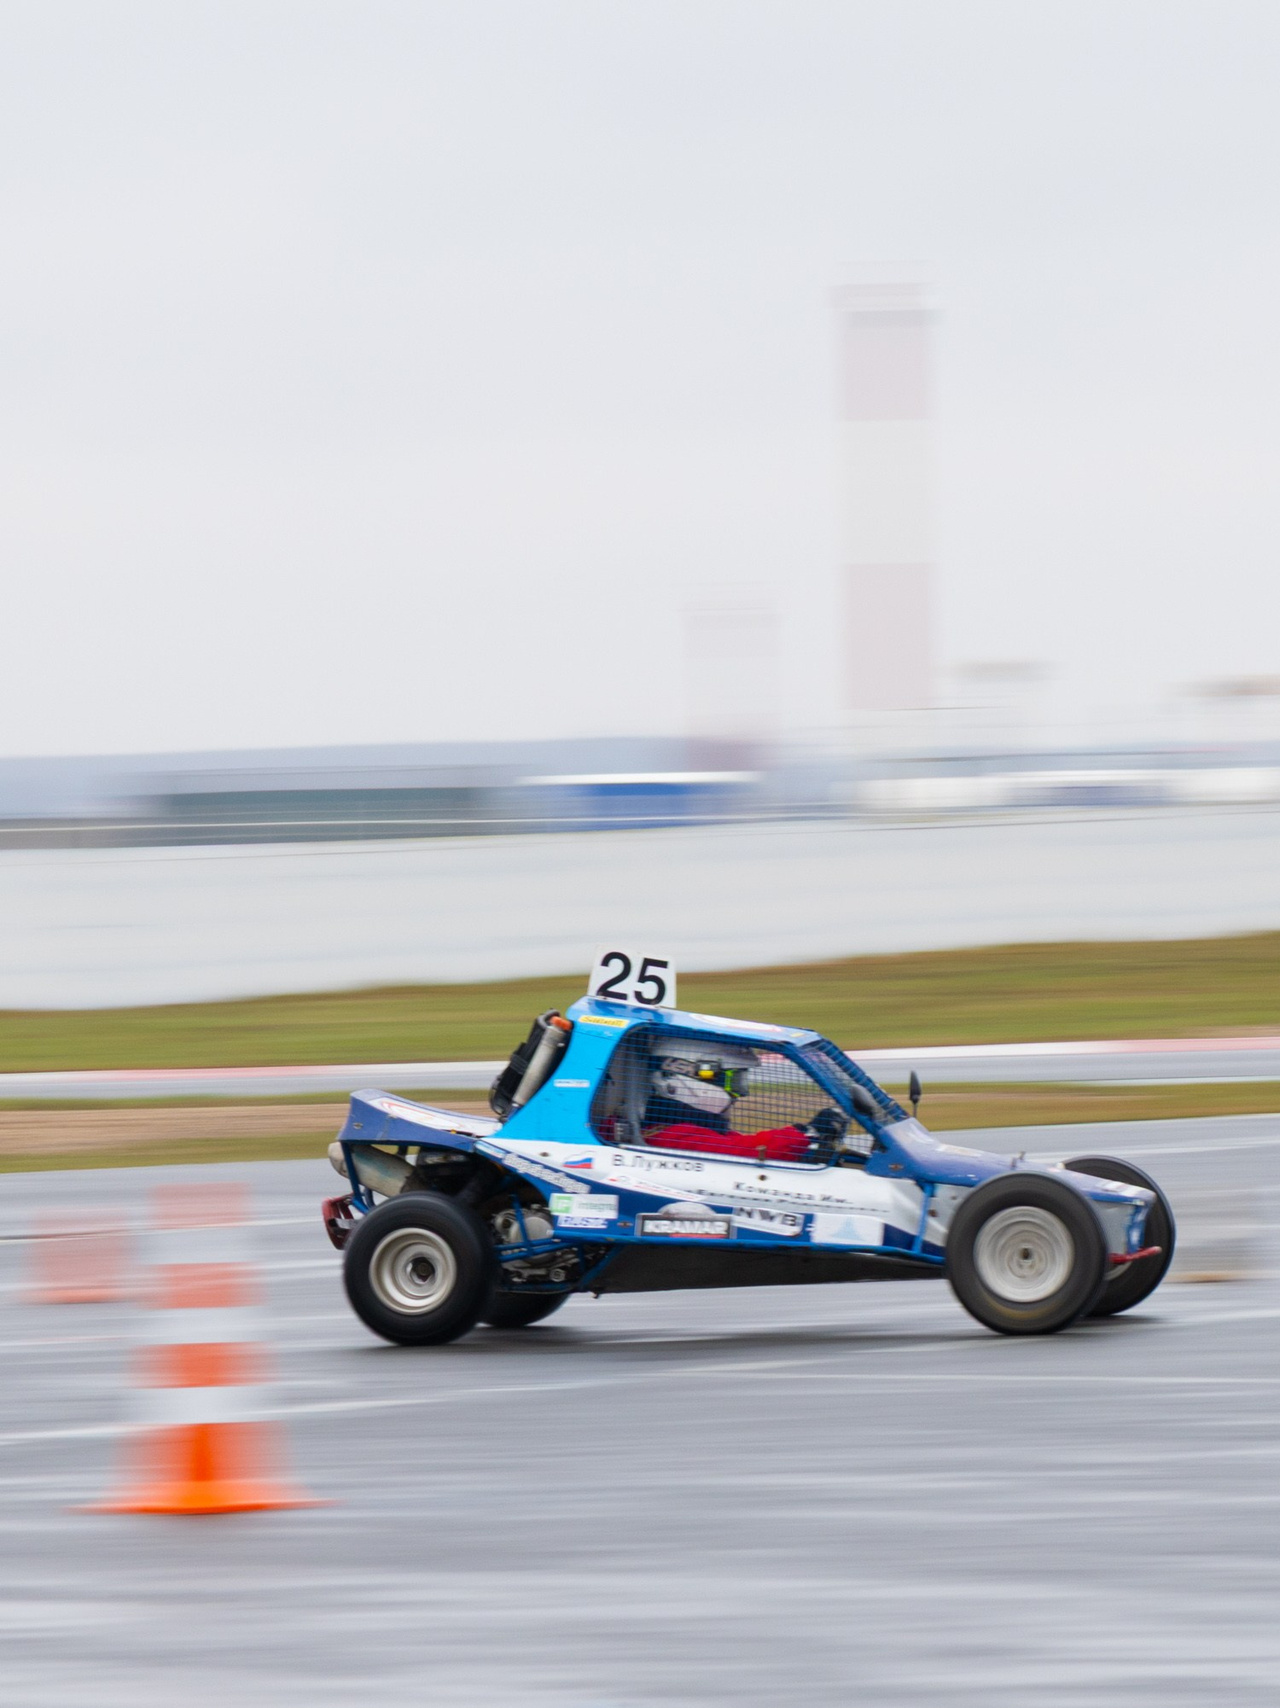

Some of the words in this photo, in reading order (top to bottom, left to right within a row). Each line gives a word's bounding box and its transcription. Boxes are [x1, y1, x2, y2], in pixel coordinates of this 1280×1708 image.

[596, 952, 668, 1006] 25
[643, 1219, 728, 1235] KRAMAR
[735, 1206, 797, 1227] NWB
